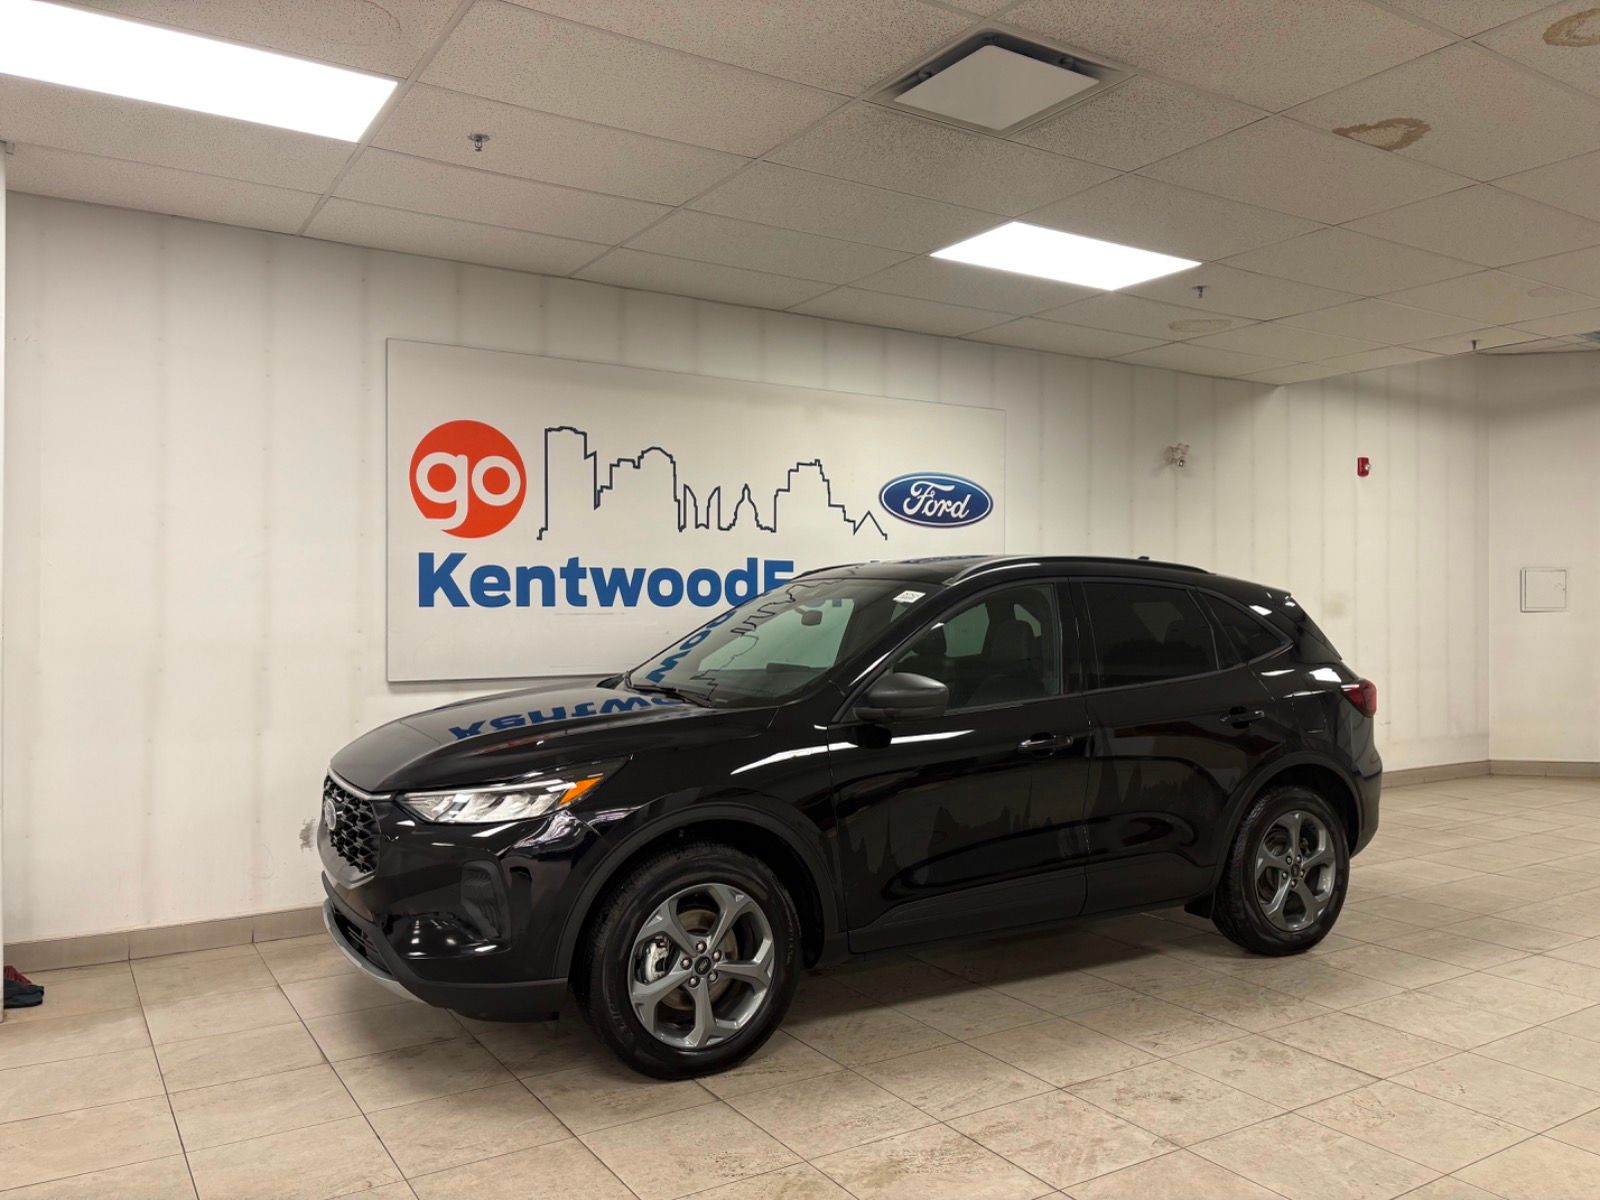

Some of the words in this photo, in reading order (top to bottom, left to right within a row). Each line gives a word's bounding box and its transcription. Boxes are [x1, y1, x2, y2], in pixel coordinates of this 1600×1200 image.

[415, 451, 521, 530] go
[903, 480, 972, 519] Ford
[418, 552, 795, 609] KentwoodF
